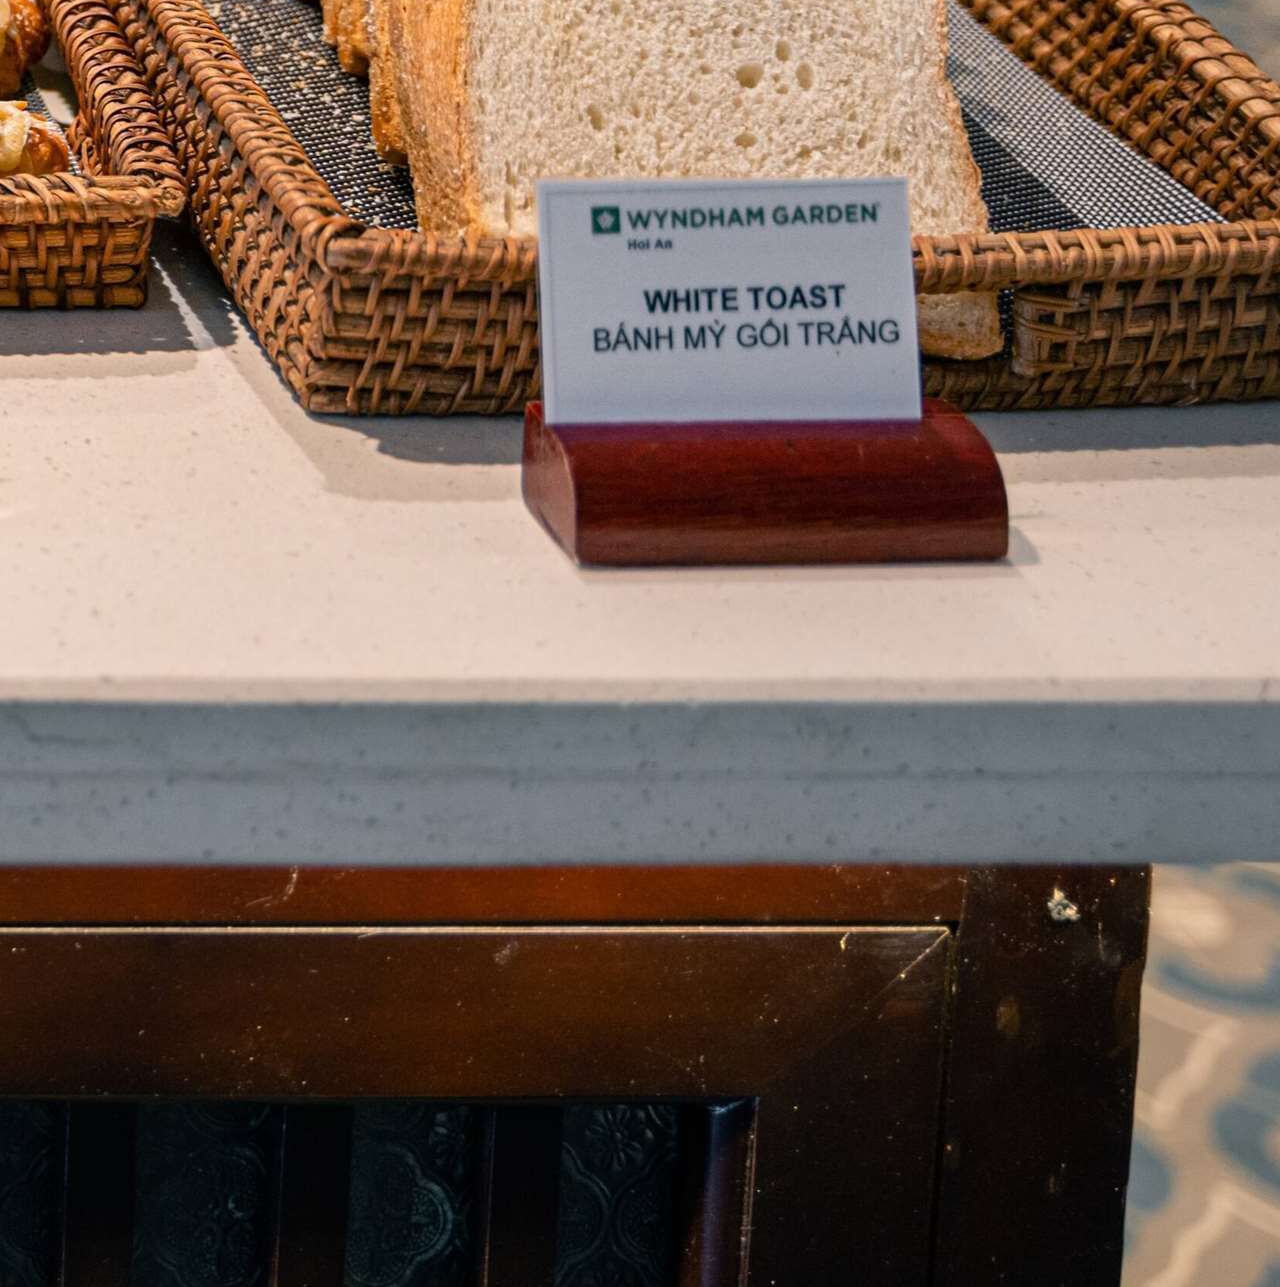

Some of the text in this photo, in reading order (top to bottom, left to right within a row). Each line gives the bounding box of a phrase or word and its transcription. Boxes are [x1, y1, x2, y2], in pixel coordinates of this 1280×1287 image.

[627, 204, 877, 229] WYNDHAM GARDEN
[655, 239, 672, 249] An
[644, 285, 845, 313] WHITE TOAST
[594, 323, 673, 352] BÁNH
